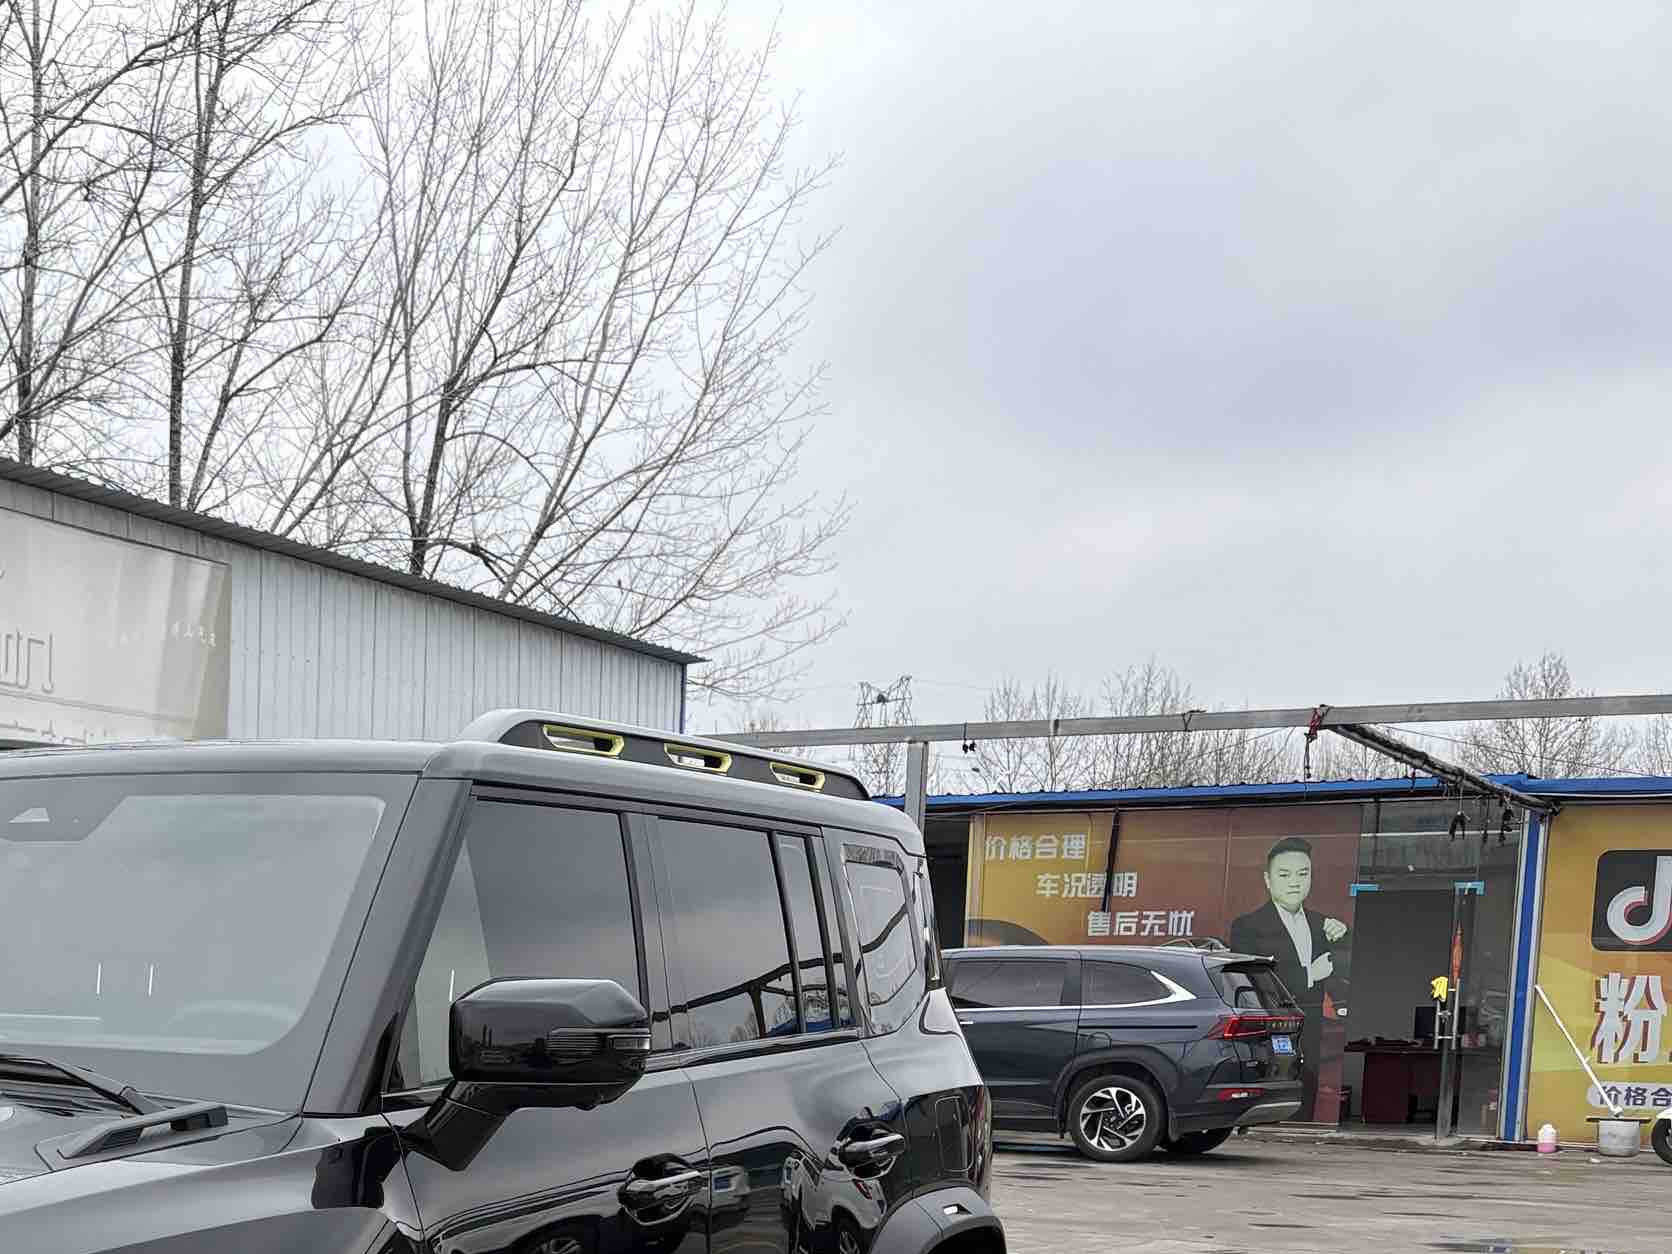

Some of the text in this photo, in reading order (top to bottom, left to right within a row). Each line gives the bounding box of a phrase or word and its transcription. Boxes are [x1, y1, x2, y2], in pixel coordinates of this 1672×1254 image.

[984, 834, 1086, 863] 价格合理
[1036, 871, 1138, 898] 车况透明
[1087, 910, 1195, 936] 售后无忧
